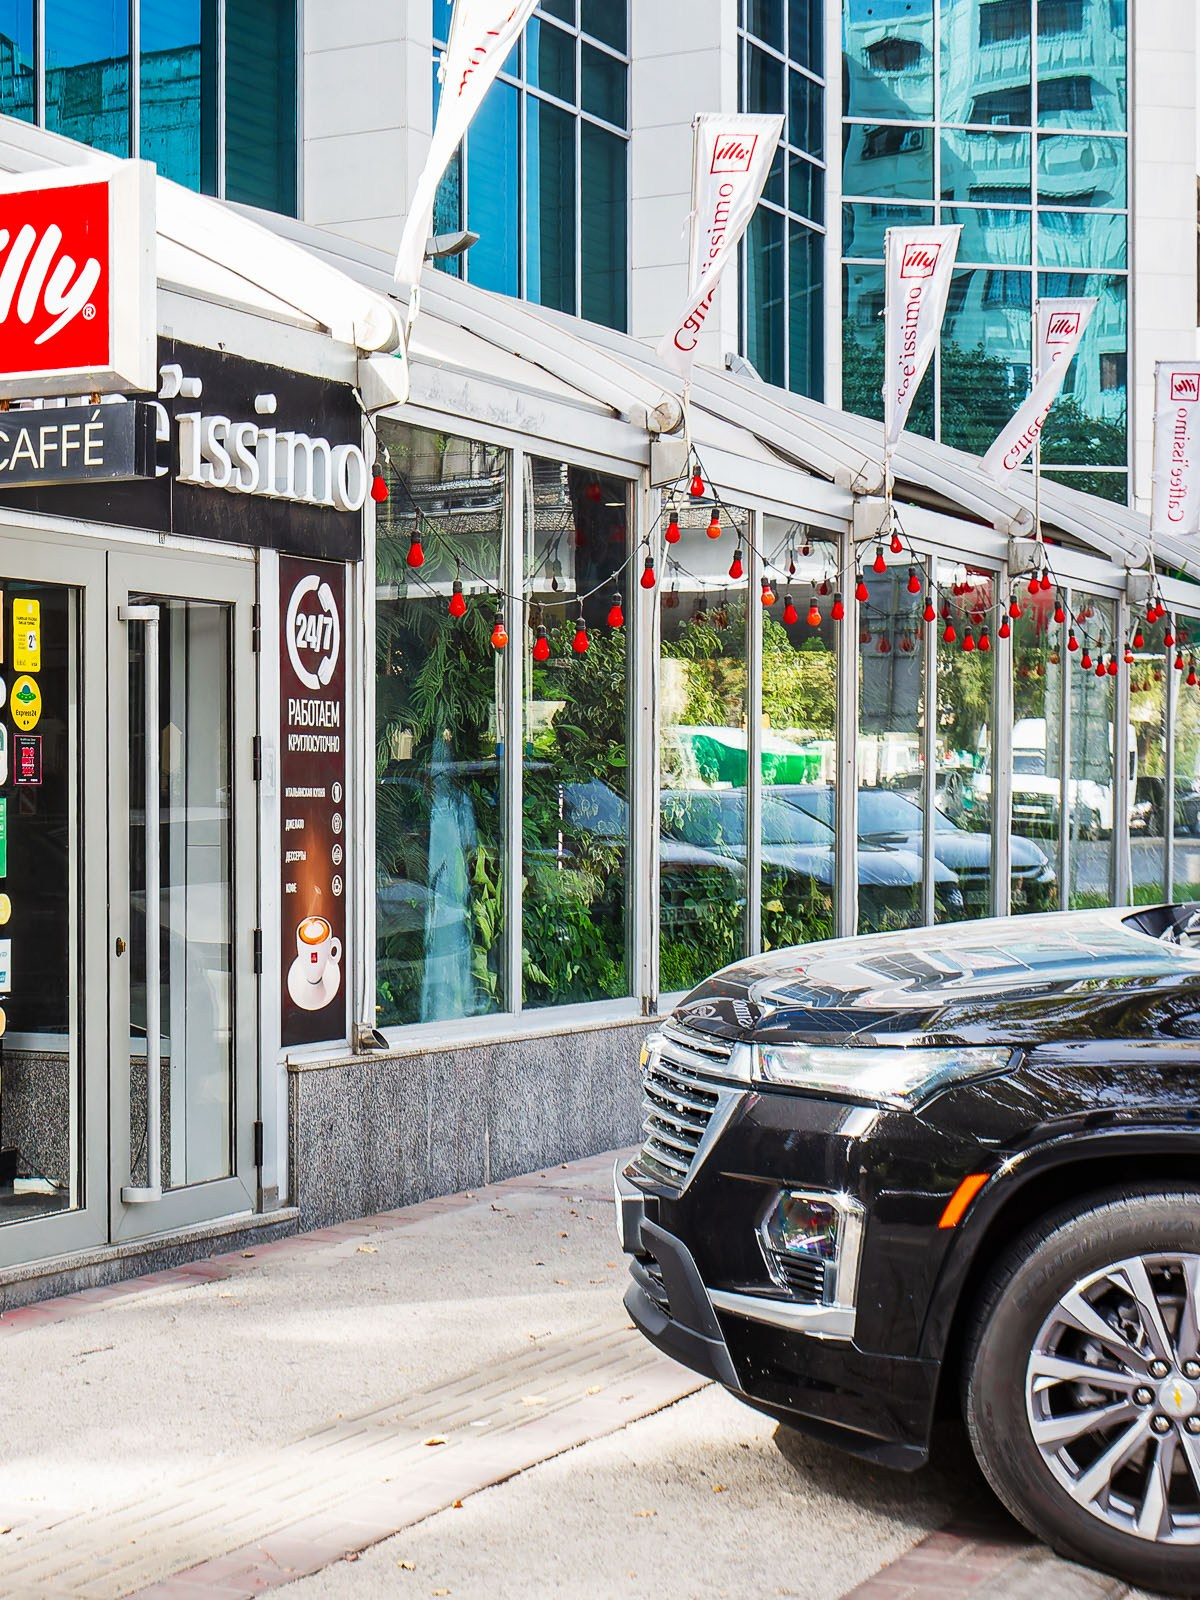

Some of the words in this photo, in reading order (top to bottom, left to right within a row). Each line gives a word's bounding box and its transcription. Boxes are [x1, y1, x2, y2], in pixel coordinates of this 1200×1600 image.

[295, 612, 334, 653] 24/7
[15, 709, 38, 718] Express24
[287, 698, 340, 728] РАБОТАЕМ
